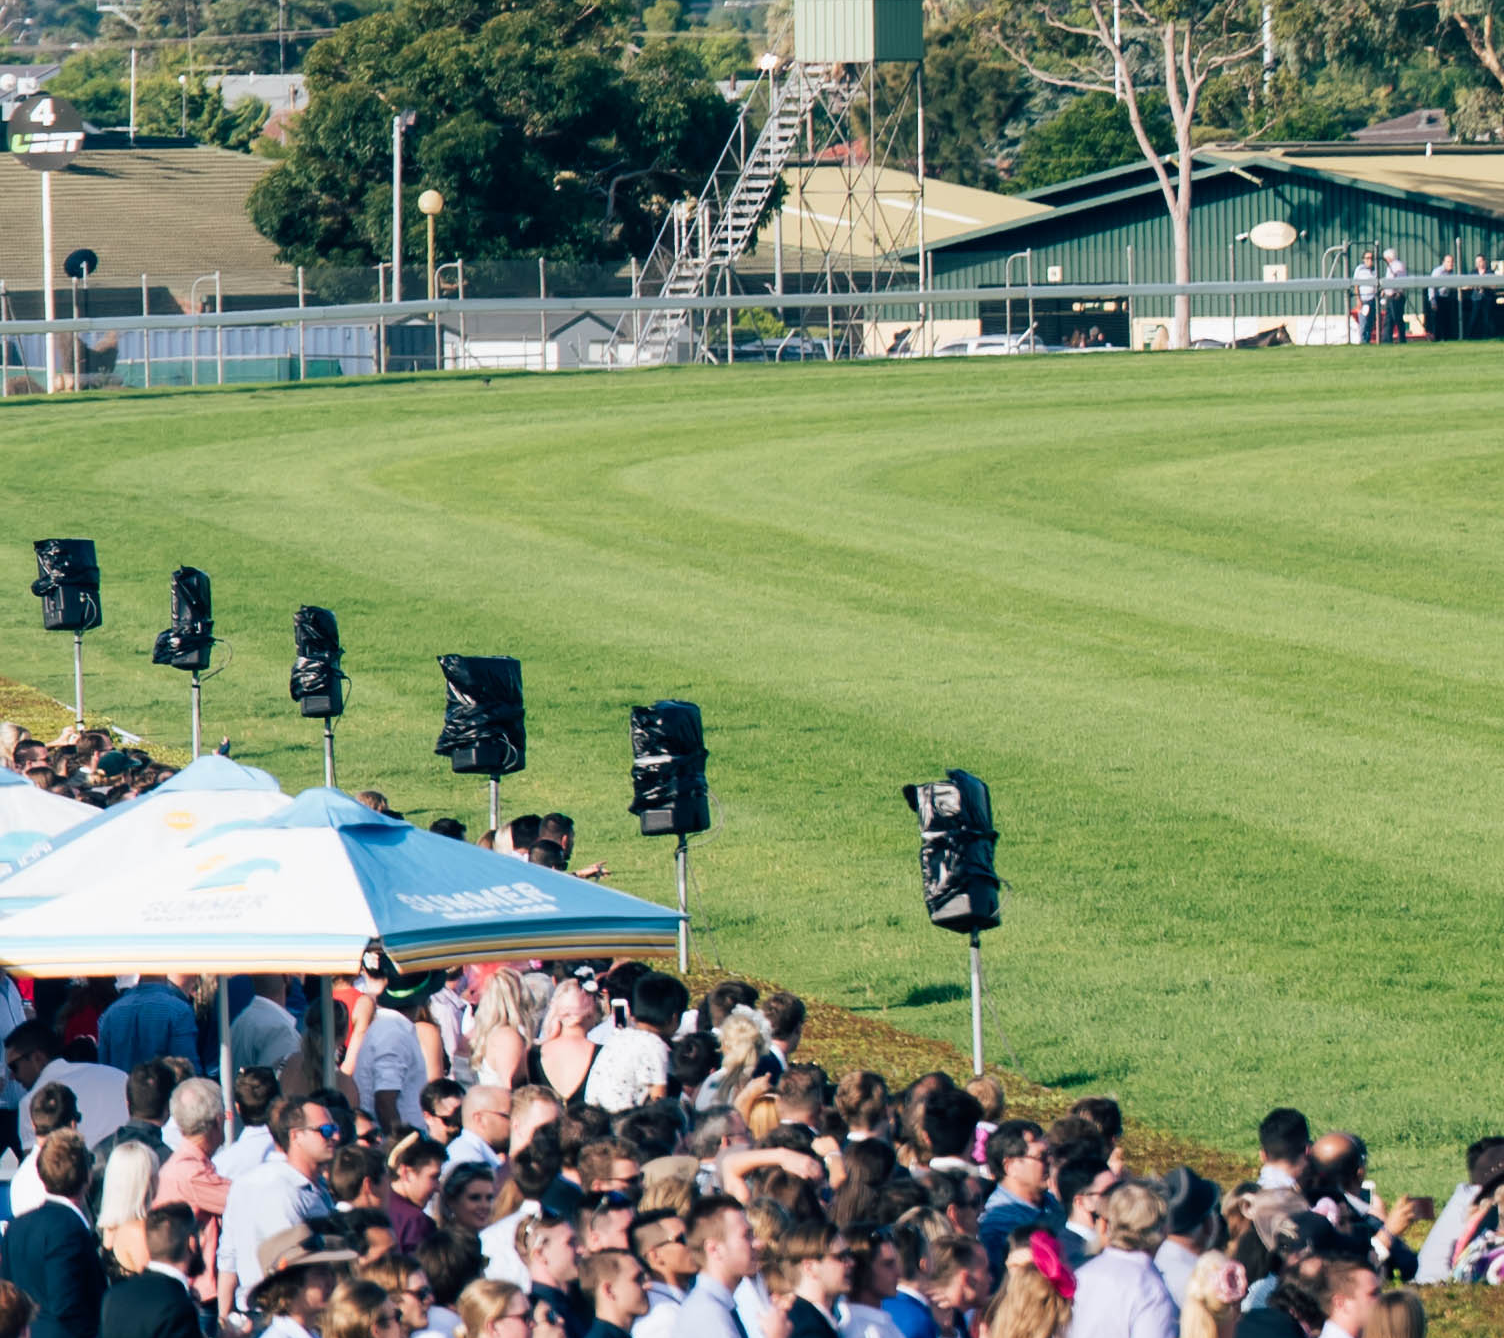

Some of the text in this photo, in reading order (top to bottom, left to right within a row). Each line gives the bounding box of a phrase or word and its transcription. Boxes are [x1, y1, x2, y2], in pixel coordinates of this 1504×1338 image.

[30, 98, 56, 126] 4
[11, 132, 86, 153] UBET
[395, 882, 557, 913] SUMMER
